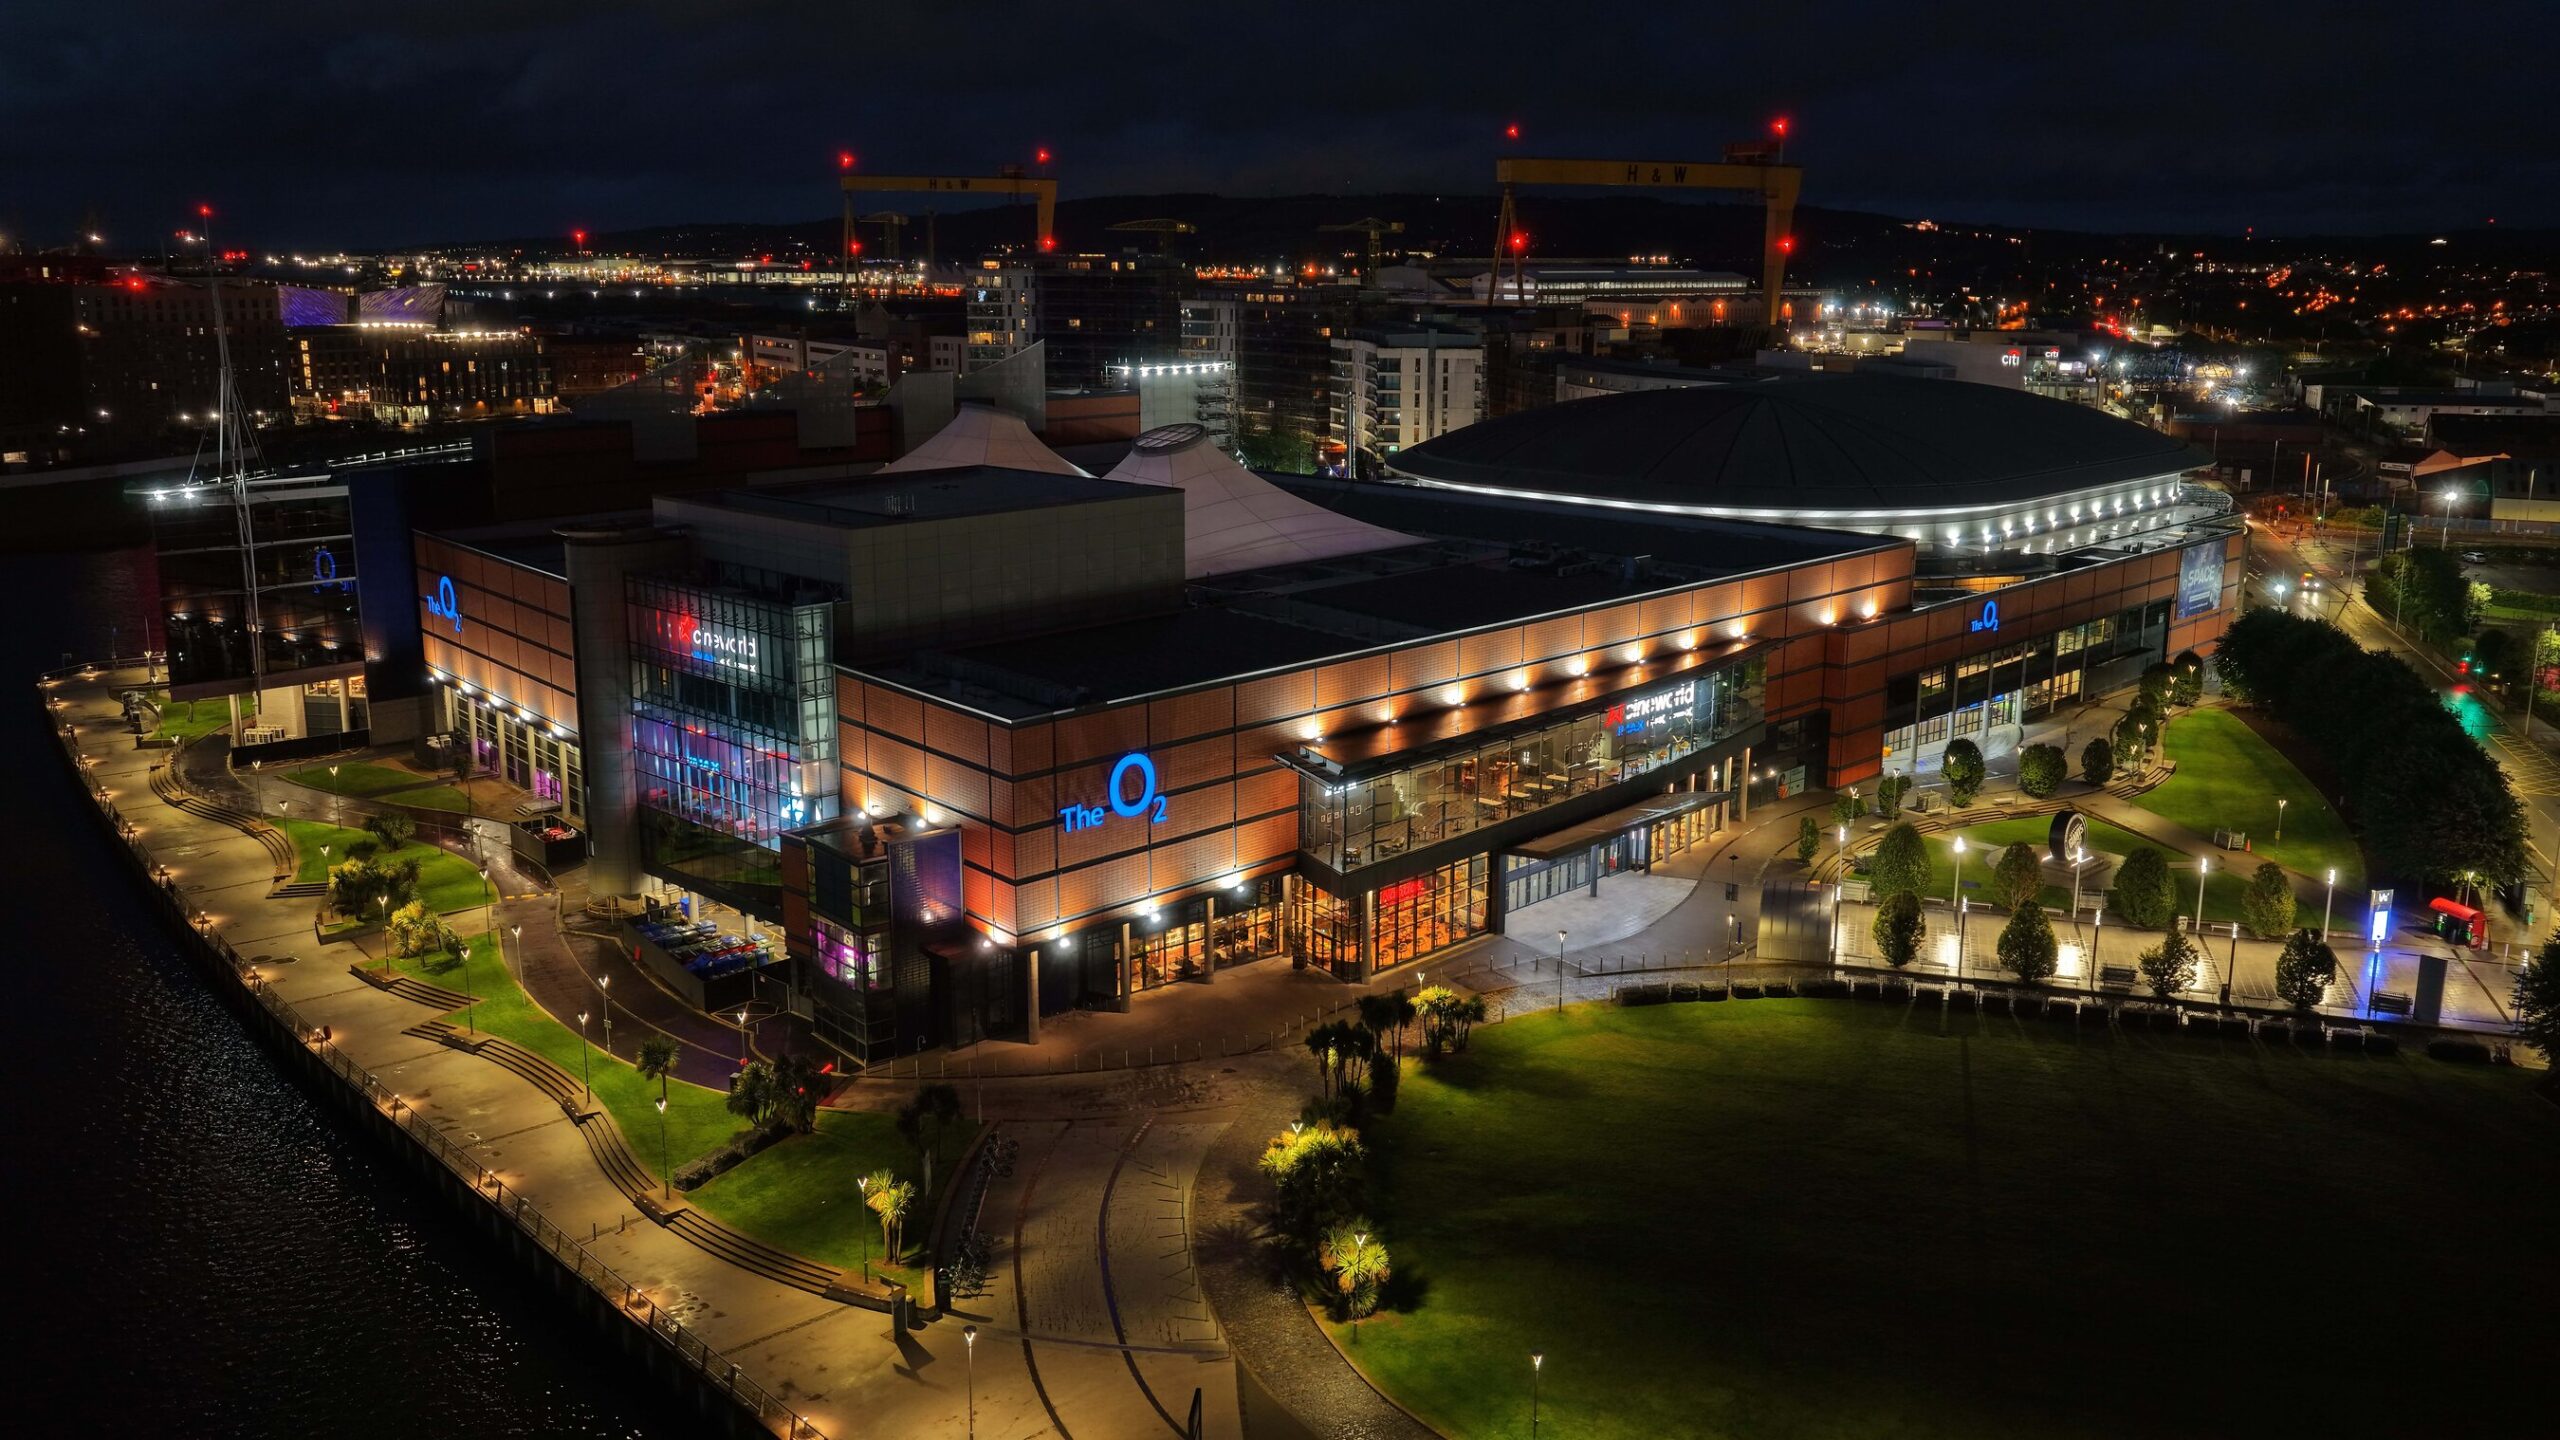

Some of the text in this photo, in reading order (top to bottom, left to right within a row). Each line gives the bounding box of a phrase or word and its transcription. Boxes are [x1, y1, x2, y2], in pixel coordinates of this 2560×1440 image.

[929, 179, 938, 190] H
[959, 179, 970, 190] W
[1627, 164, 1688, 183] H & W
[2188, 564, 2216, 588] SPACE
[426, 576, 462, 633] The O2
[1971, 600, 1999, 632] The O2
[1060, 753, 1168, 833] The O2
